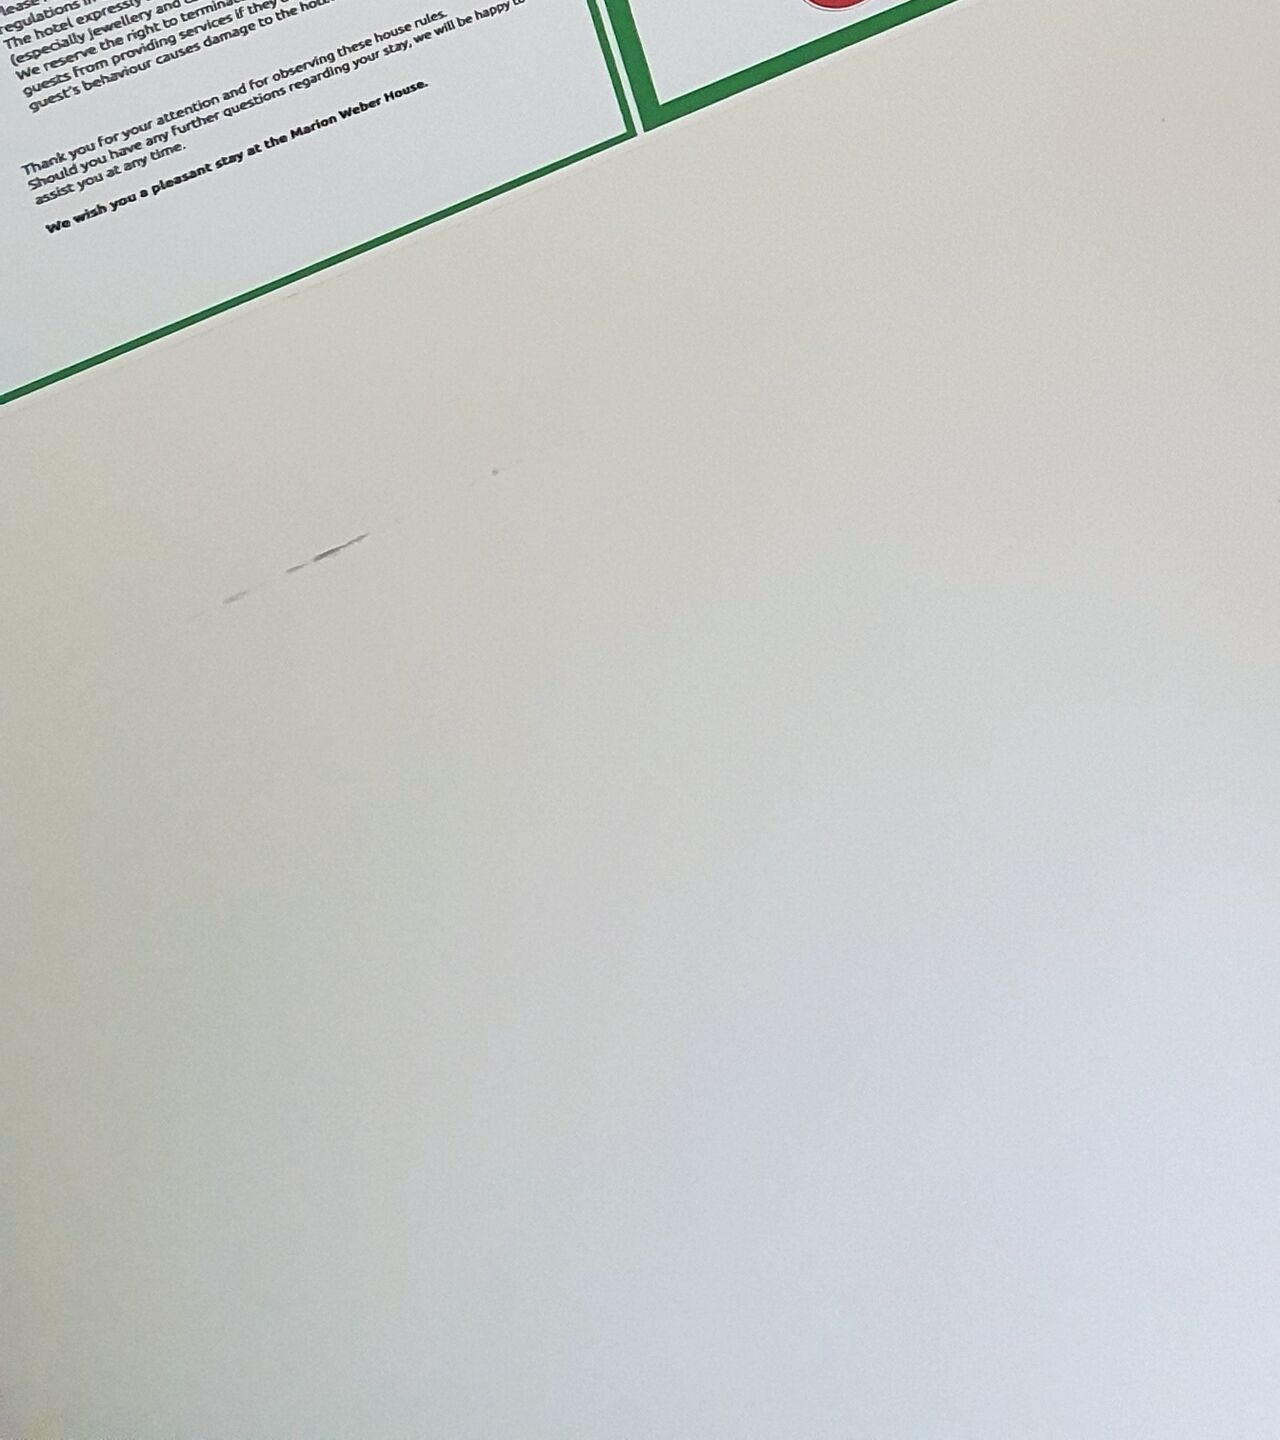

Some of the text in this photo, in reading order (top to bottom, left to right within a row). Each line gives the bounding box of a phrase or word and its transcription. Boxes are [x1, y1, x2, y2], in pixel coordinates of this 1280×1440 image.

[9, 31, 85, 67] (especially
[87, 8, 152, 41] jewellery
[20, 10, 447, 175] Thank you for your attention and for observing these house rules.
[44, 81, 428, 233] We wish you a pleasant stay at the Marion Weber House.
